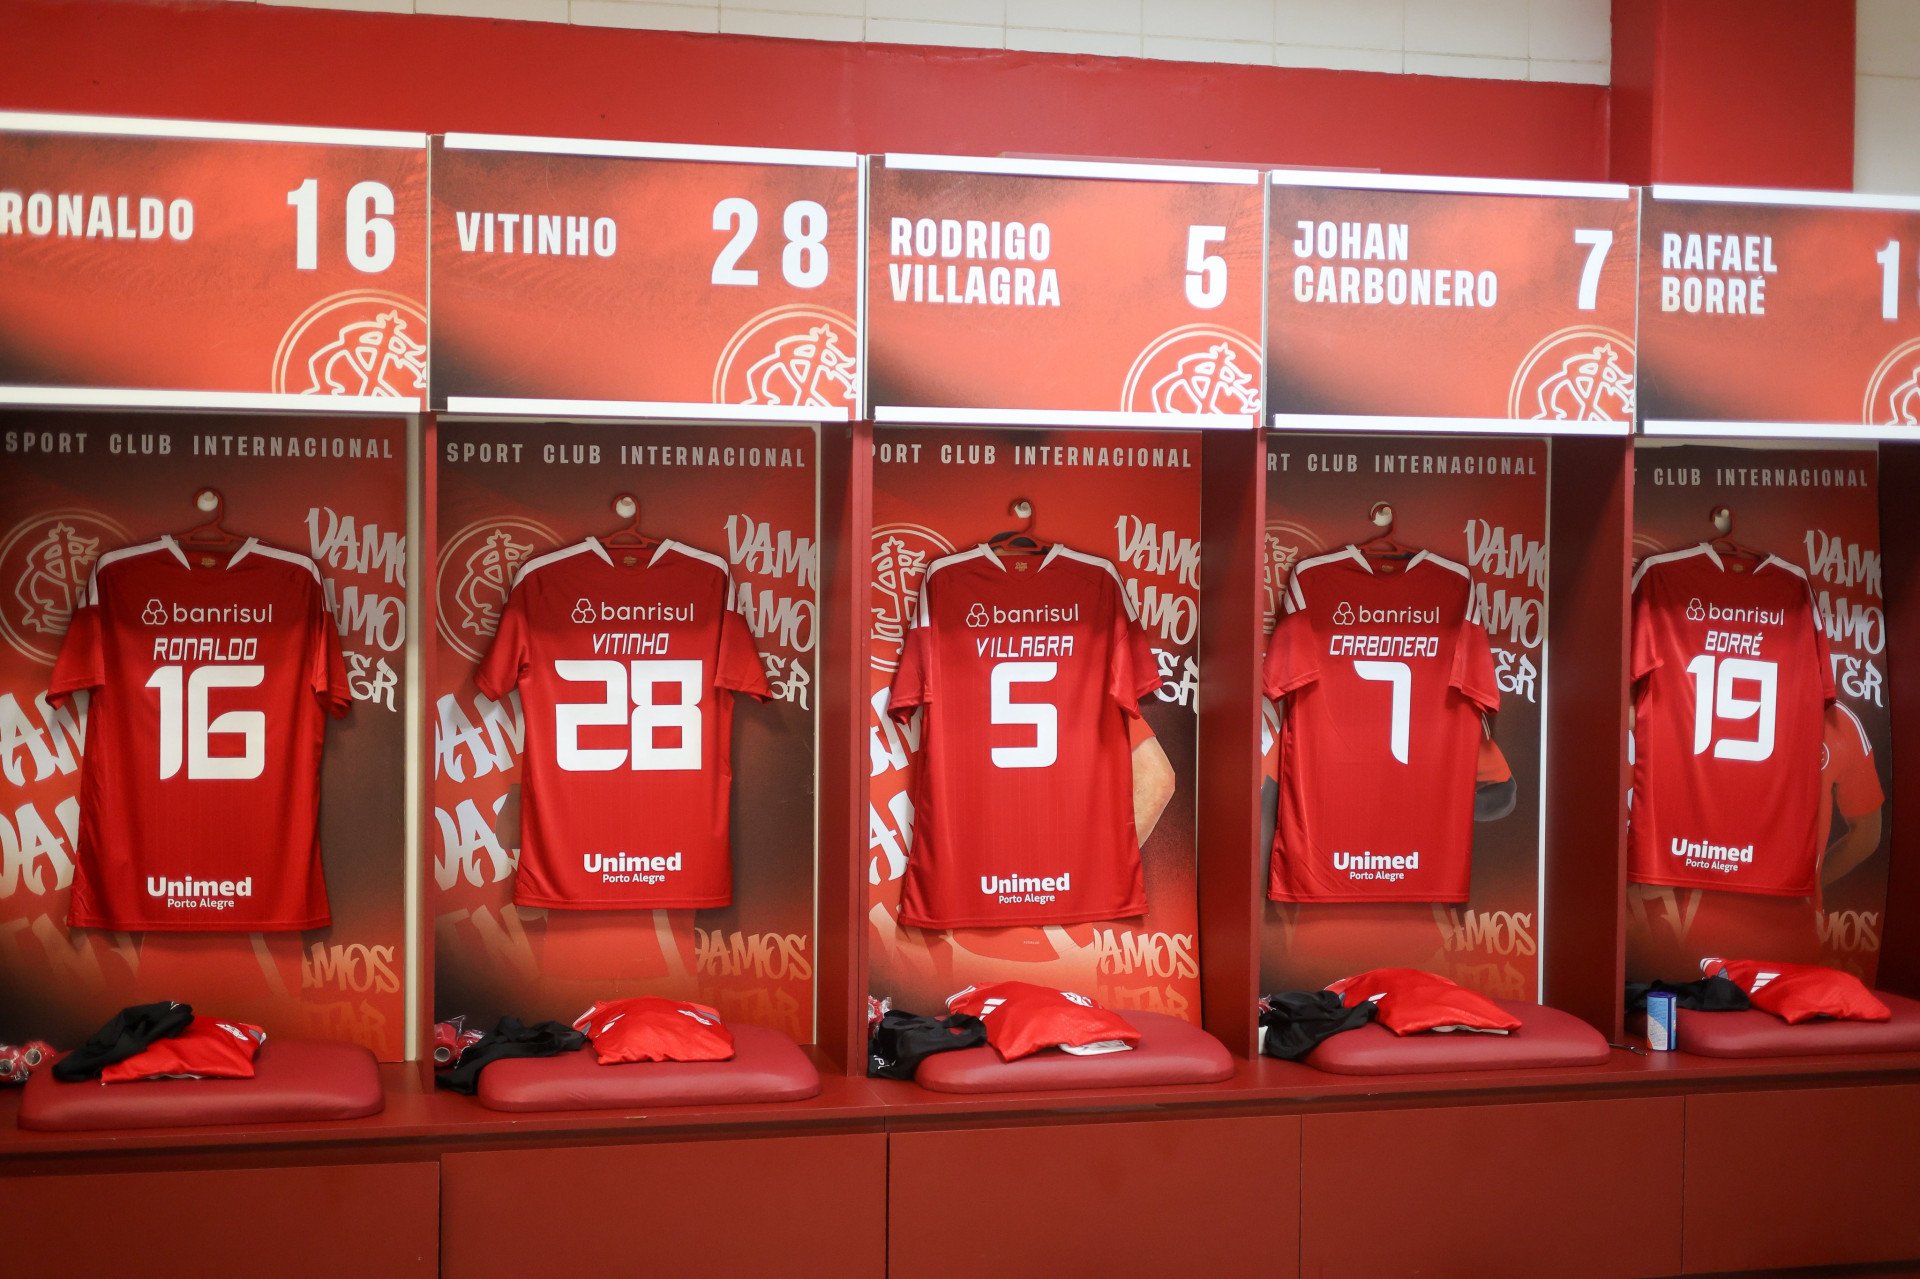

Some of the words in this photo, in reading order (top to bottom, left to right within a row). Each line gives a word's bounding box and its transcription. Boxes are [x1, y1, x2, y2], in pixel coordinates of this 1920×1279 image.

[0, 192, 195, 241] RONALDO
[456, 211, 617, 257] VITINHO
[890, 217, 1050, 261] RODRIGO
[1294, 221, 1409, 261] JOHAN
[1661, 233, 1778, 273] RAFAEL
[1185, 225, 1228, 309] 5
[1574, 229, 1613, 310] 7
[889, 263, 1061, 307] VILLAGRA
[1294, 266, 1498, 308] CARBONERO
[1661, 276, 1766, 315] BORRÉ
[5, 431, 88, 454] SPORT
[109, 433, 172, 456] CLUB
[193, 434, 393, 459] INTERNACIONAL
[446, 442, 524, 464] SPORT
[543, 444, 602, 465] CLUB
[620, 446, 806, 468] INTERNACIONAL
[940, 444, 997, 465] CLUB
[1014, 446, 1192, 468] INTERNACIONAL
[1307, 453, 1358, 473] CLUB
[1374, 454, 1537, 475] INTERNACIONAL
[1653, 467, 1701, 486] CLUB
[1716, 468, 1868, 487] INTERNACIONAL
[172, 602, 273, 623] banrisul
[601, 601, 694, 622] banrisul
[993, 603, 1079, 624] banrisul
[1359, 605, 1440, 625] banrisul
[1709, 602, 1784, 626] banrisul
[153, 637, 258, 661] RONALDO
[592, 632, 670, 655] VITINHO
[976, 635, 1074, 658] VILLAGRA
[1329, 635, 1439, 658] CARBONERO
[1704, 630, 1764, 656] BORRÉ
[554, 659, 702, 771] 28
[990, 661, 1058, 768] 5
[1353, 660, 1412, 765] 7
[1686, 655, 1778, 762] 19
[145, 665, 265, 780] 16
[583, 852, 682, 872] Unimed
[1333, 851, 1419, 870] Unimed
[1671, 837, 1754, 863] Unimed
[1349, 871, 1374, 880] Porto
[1375, 871, 1404, 882] Alegre
[1685, 858, 1710, 869] Porto
[1711, 861, 1738, 873] Alegre
[147, 875, 252, 897] Unimed
[602, 873, 630, 884] Porto
[631, 873, 665, 885] Alegre
[980, 872, 1070, 895] Unimed
[167, 898, 197, 908] Porto
[199, 898, 235, 910] Alegre
[998, 894, 1023, 904] Porto
[1024, 893, 1055, 905] Alegre
